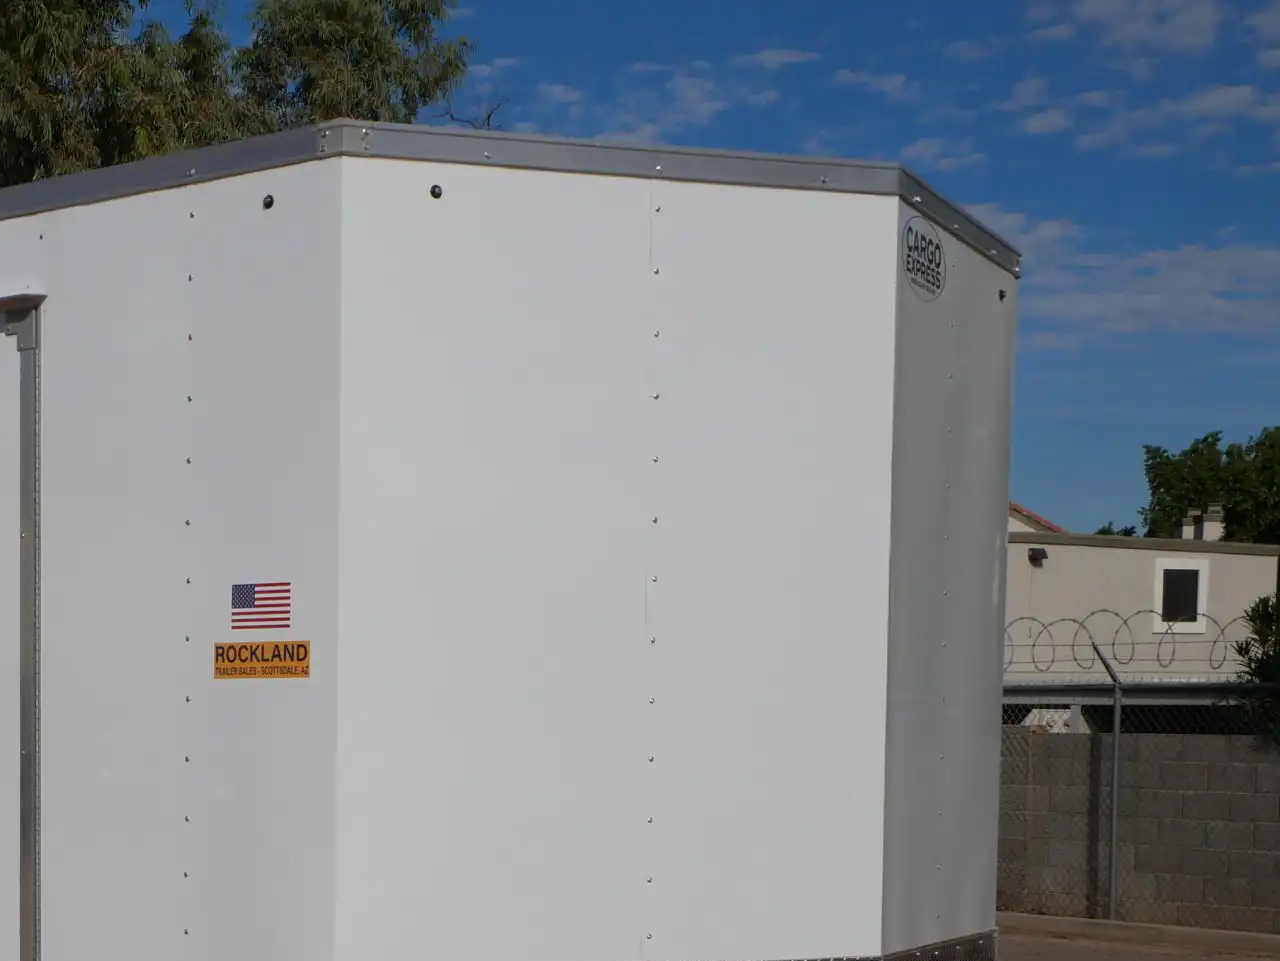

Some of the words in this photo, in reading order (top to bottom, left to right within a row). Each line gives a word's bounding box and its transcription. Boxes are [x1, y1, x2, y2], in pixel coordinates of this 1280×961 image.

[906, 226, 942, 269] CARGO
[906, 253, 941, 289] EXPRESS
[215, 643, 308, 663] ROCKLAND
[215, 667, 238, 676] TRAILER
[239, 666, 257, 676] SALES
[300, 665, 309, 675] AZ
